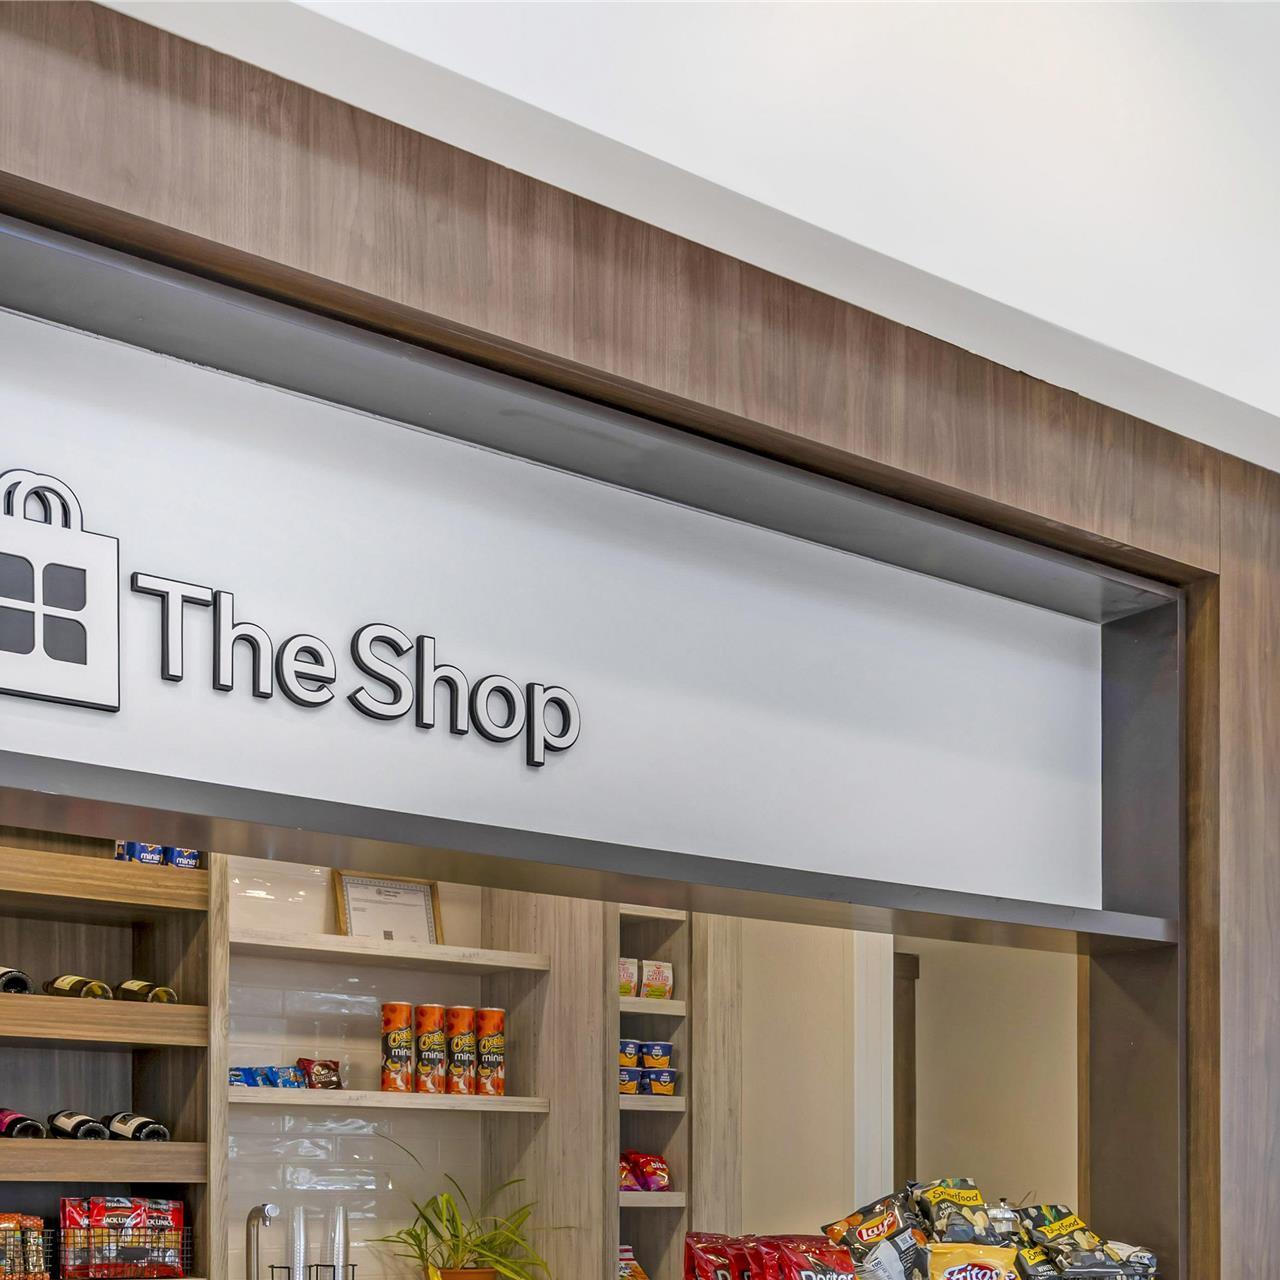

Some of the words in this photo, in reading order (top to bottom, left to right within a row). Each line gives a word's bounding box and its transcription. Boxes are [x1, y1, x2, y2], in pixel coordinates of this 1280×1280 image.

[131, 571, 337, 707] The
[347, 622, 582, 767] Shop
[141, 852, 161, 861] minis
[176, 857, 197, 866] minis
[862, 1212, 895, 1241] Lay's
[871, 1260, 882, 1269] 100
